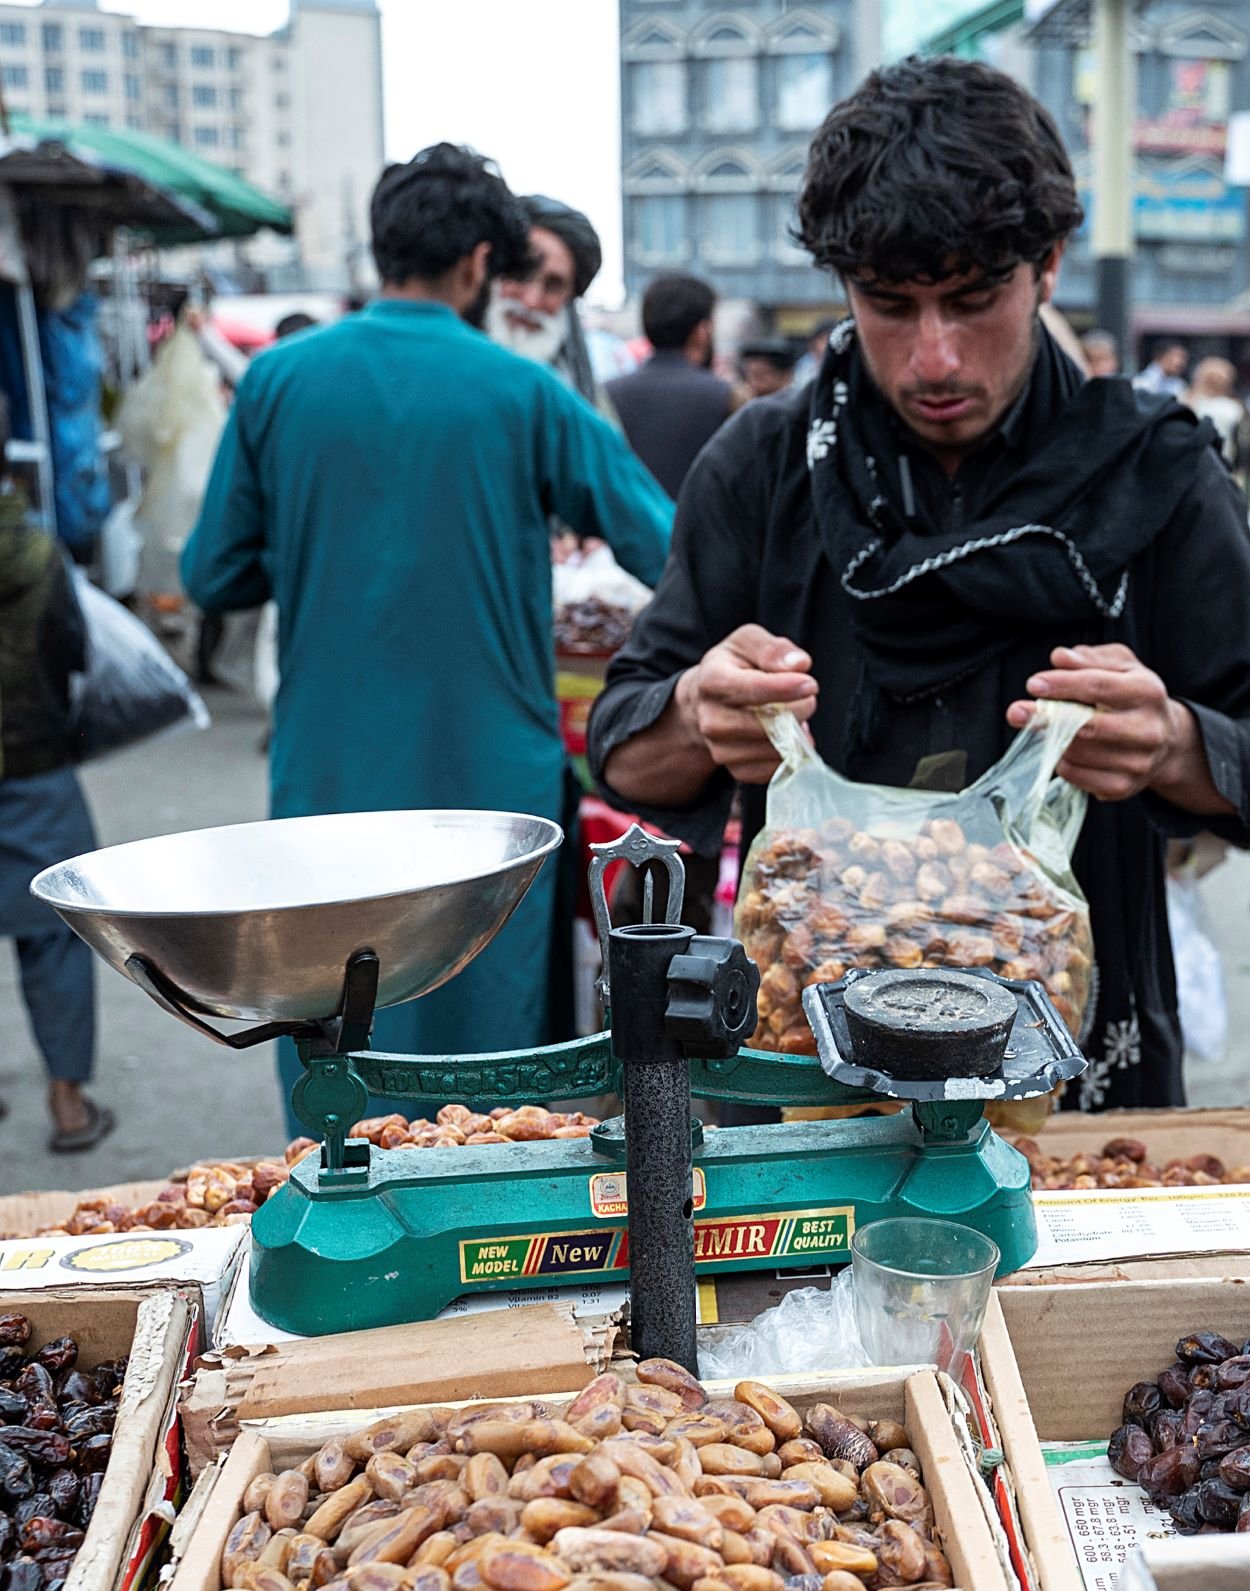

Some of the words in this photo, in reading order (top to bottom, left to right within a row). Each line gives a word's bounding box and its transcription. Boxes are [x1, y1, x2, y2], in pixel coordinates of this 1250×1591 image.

[802, 1219, 835, 1234] BEST
[793, 1233, 844, 1250] QUALITY
[478, 1245, 509, 1260] NEW
[550, 1244, 603, 1264] New
[471, 1259, 519, 1275] MODEL
[508, 1295, 545, 1303] Vitamin
[1071, 1497, 1085, 1517] mgr
[1086, 1498, 1099, 1516] mgr
[1102, 1498, 1115, 1516] mgr
[1115, 1496, 1130, 1514] mgr
[1075, 1519, 1091, 1537] 650
[1090, 1517, 1105, 1536] 67.8
[1106, 1517, 1121, 1536] 63.8
[1122, 1524, 1137, 1535] 51
[1083, 1545, 1098, 1563] 600
[1098, 1543, 1113, 1562] 58.3
